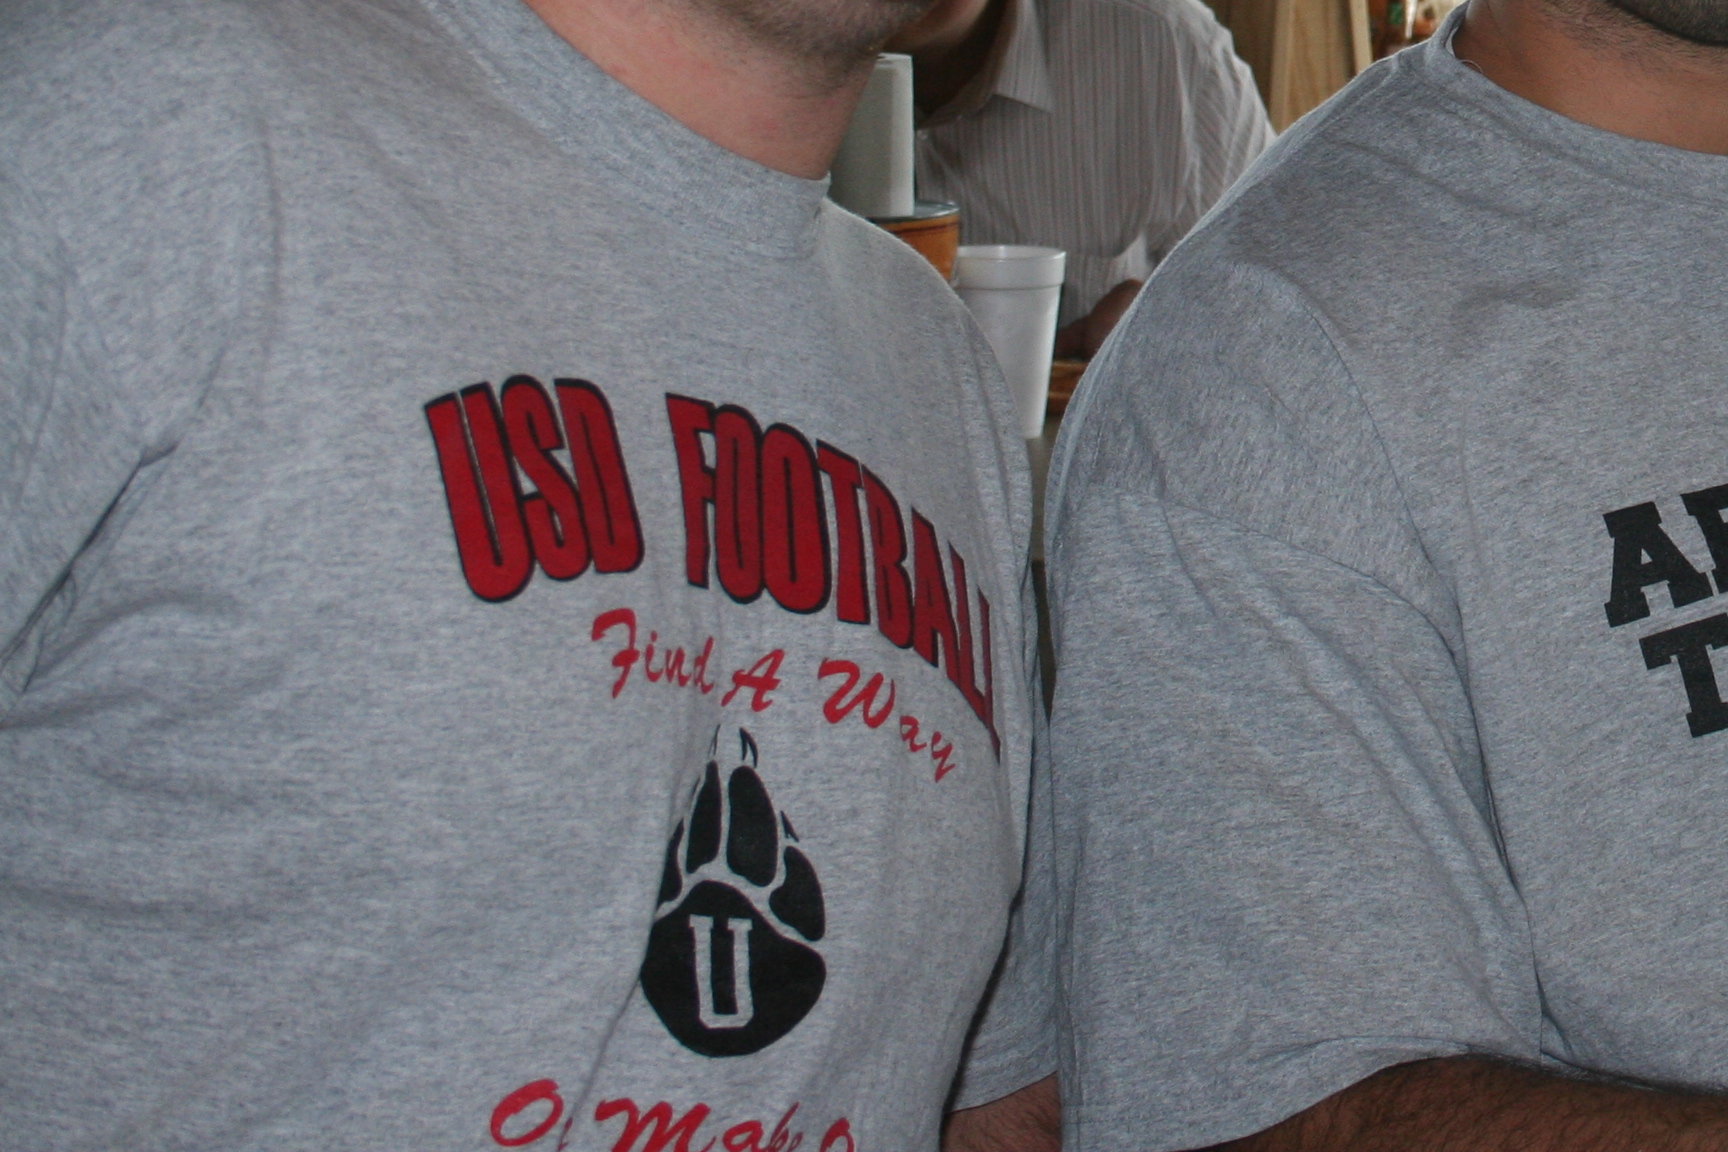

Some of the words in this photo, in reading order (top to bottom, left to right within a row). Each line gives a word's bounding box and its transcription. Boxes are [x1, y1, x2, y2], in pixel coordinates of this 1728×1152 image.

[424, 374, 645, 603] USD
[665, 392, 1001, 765] FOOTBALL
[591, 608, 715, 699] Find
[721, 649, 785, 712] A
[817, 658, 957, 783] Way
[689, 914, 754, 1029] U
